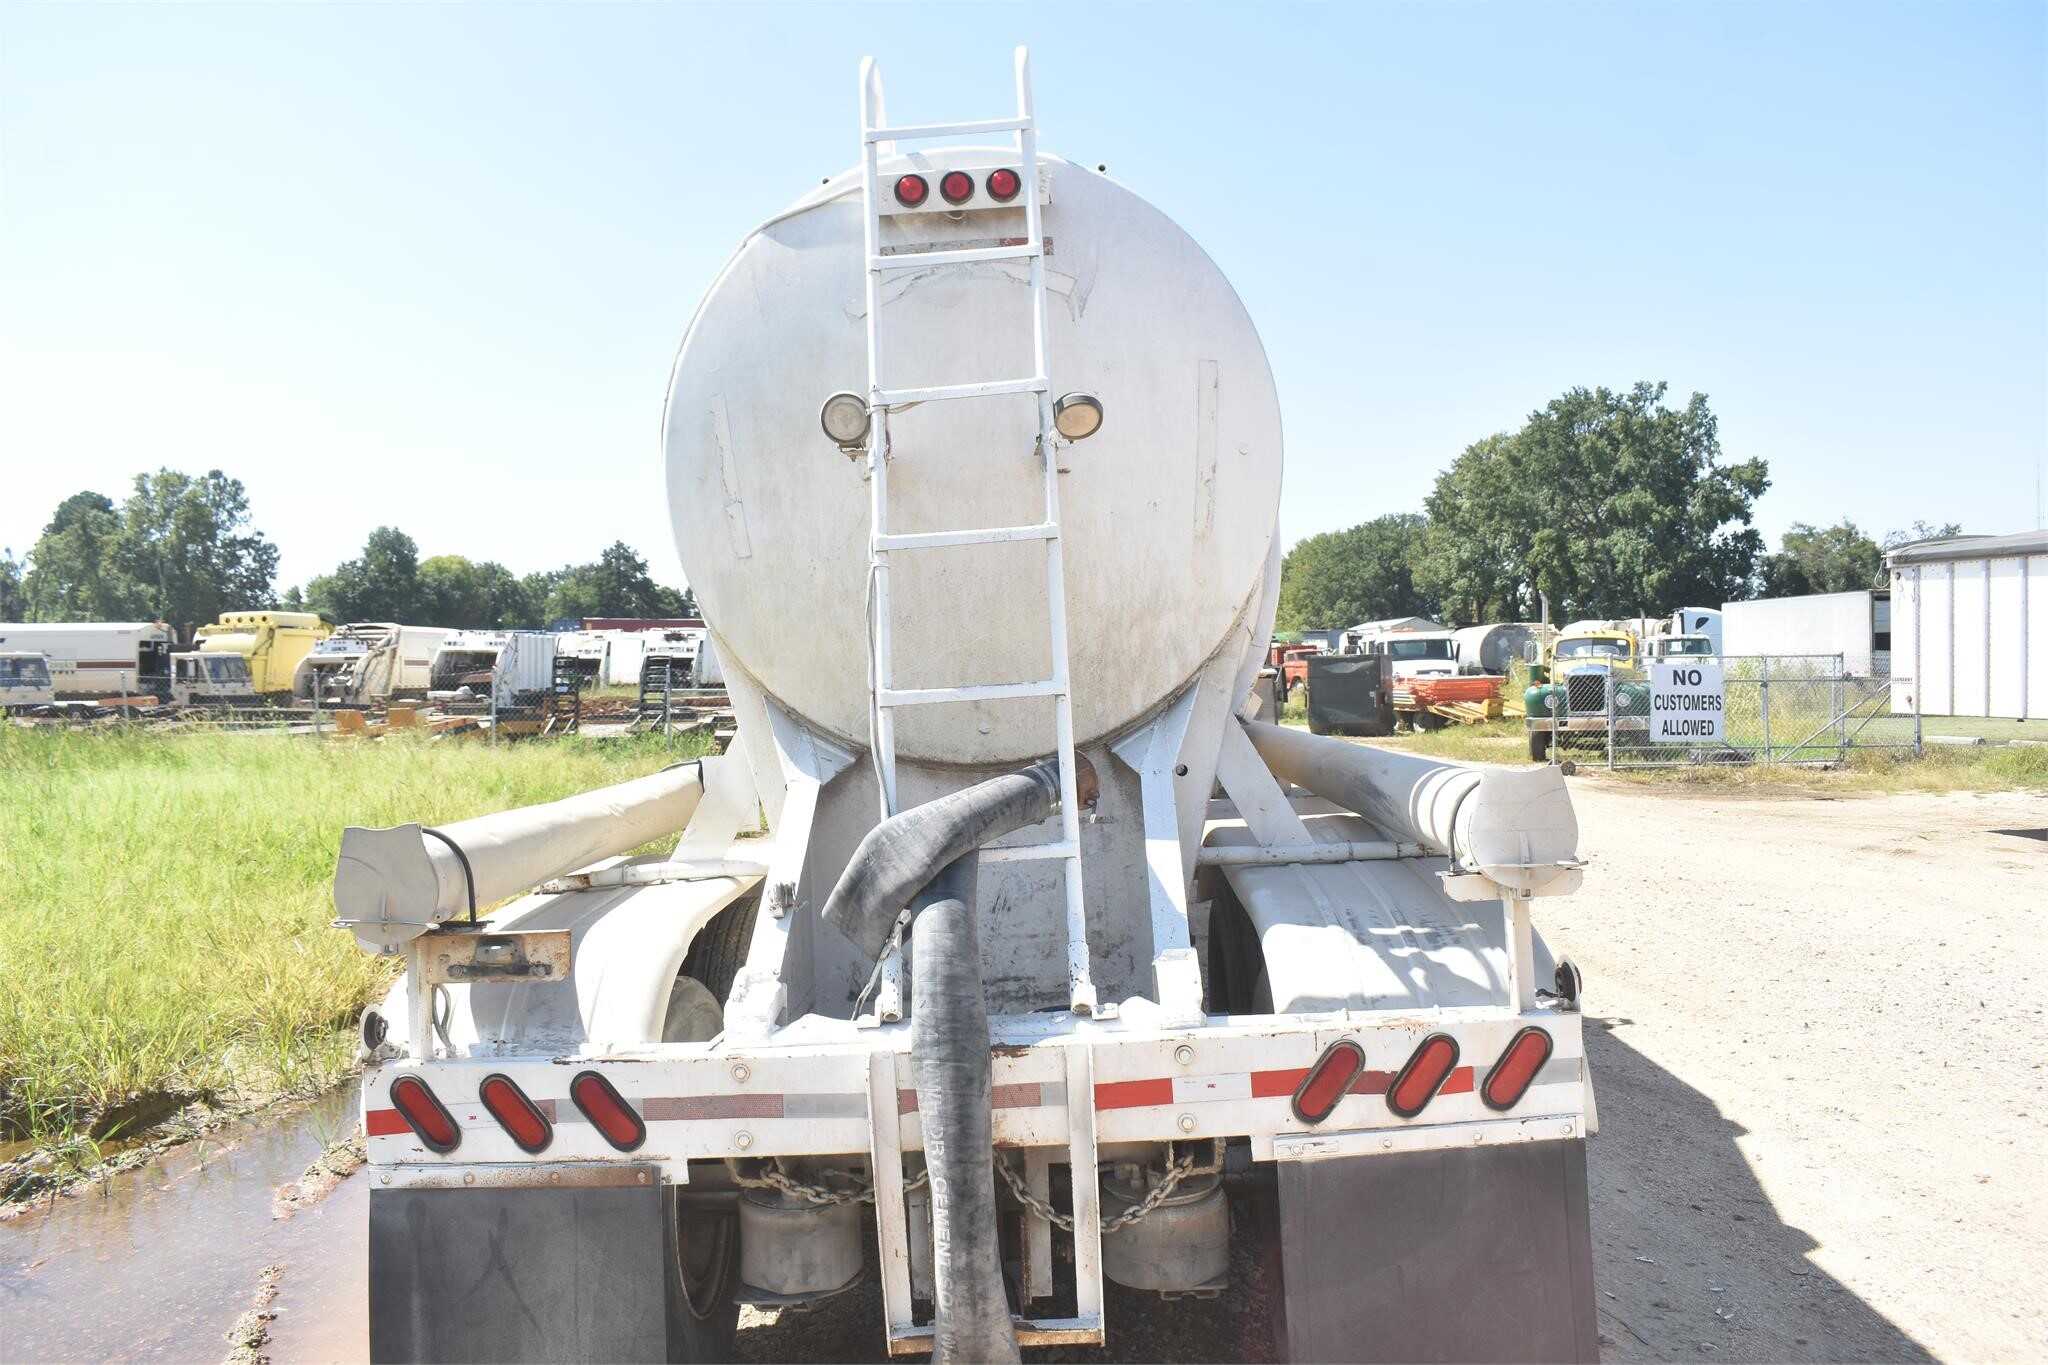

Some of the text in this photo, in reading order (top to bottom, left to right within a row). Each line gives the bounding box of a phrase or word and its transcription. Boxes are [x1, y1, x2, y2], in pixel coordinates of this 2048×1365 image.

[1672, 669, 1702, 686] NO
[1654, 694, 1722, 711] CUSTOMERS
[1662, 719, 1715, 736] ALLOWED
[934, 1176, 952, 1272] CEMENT
